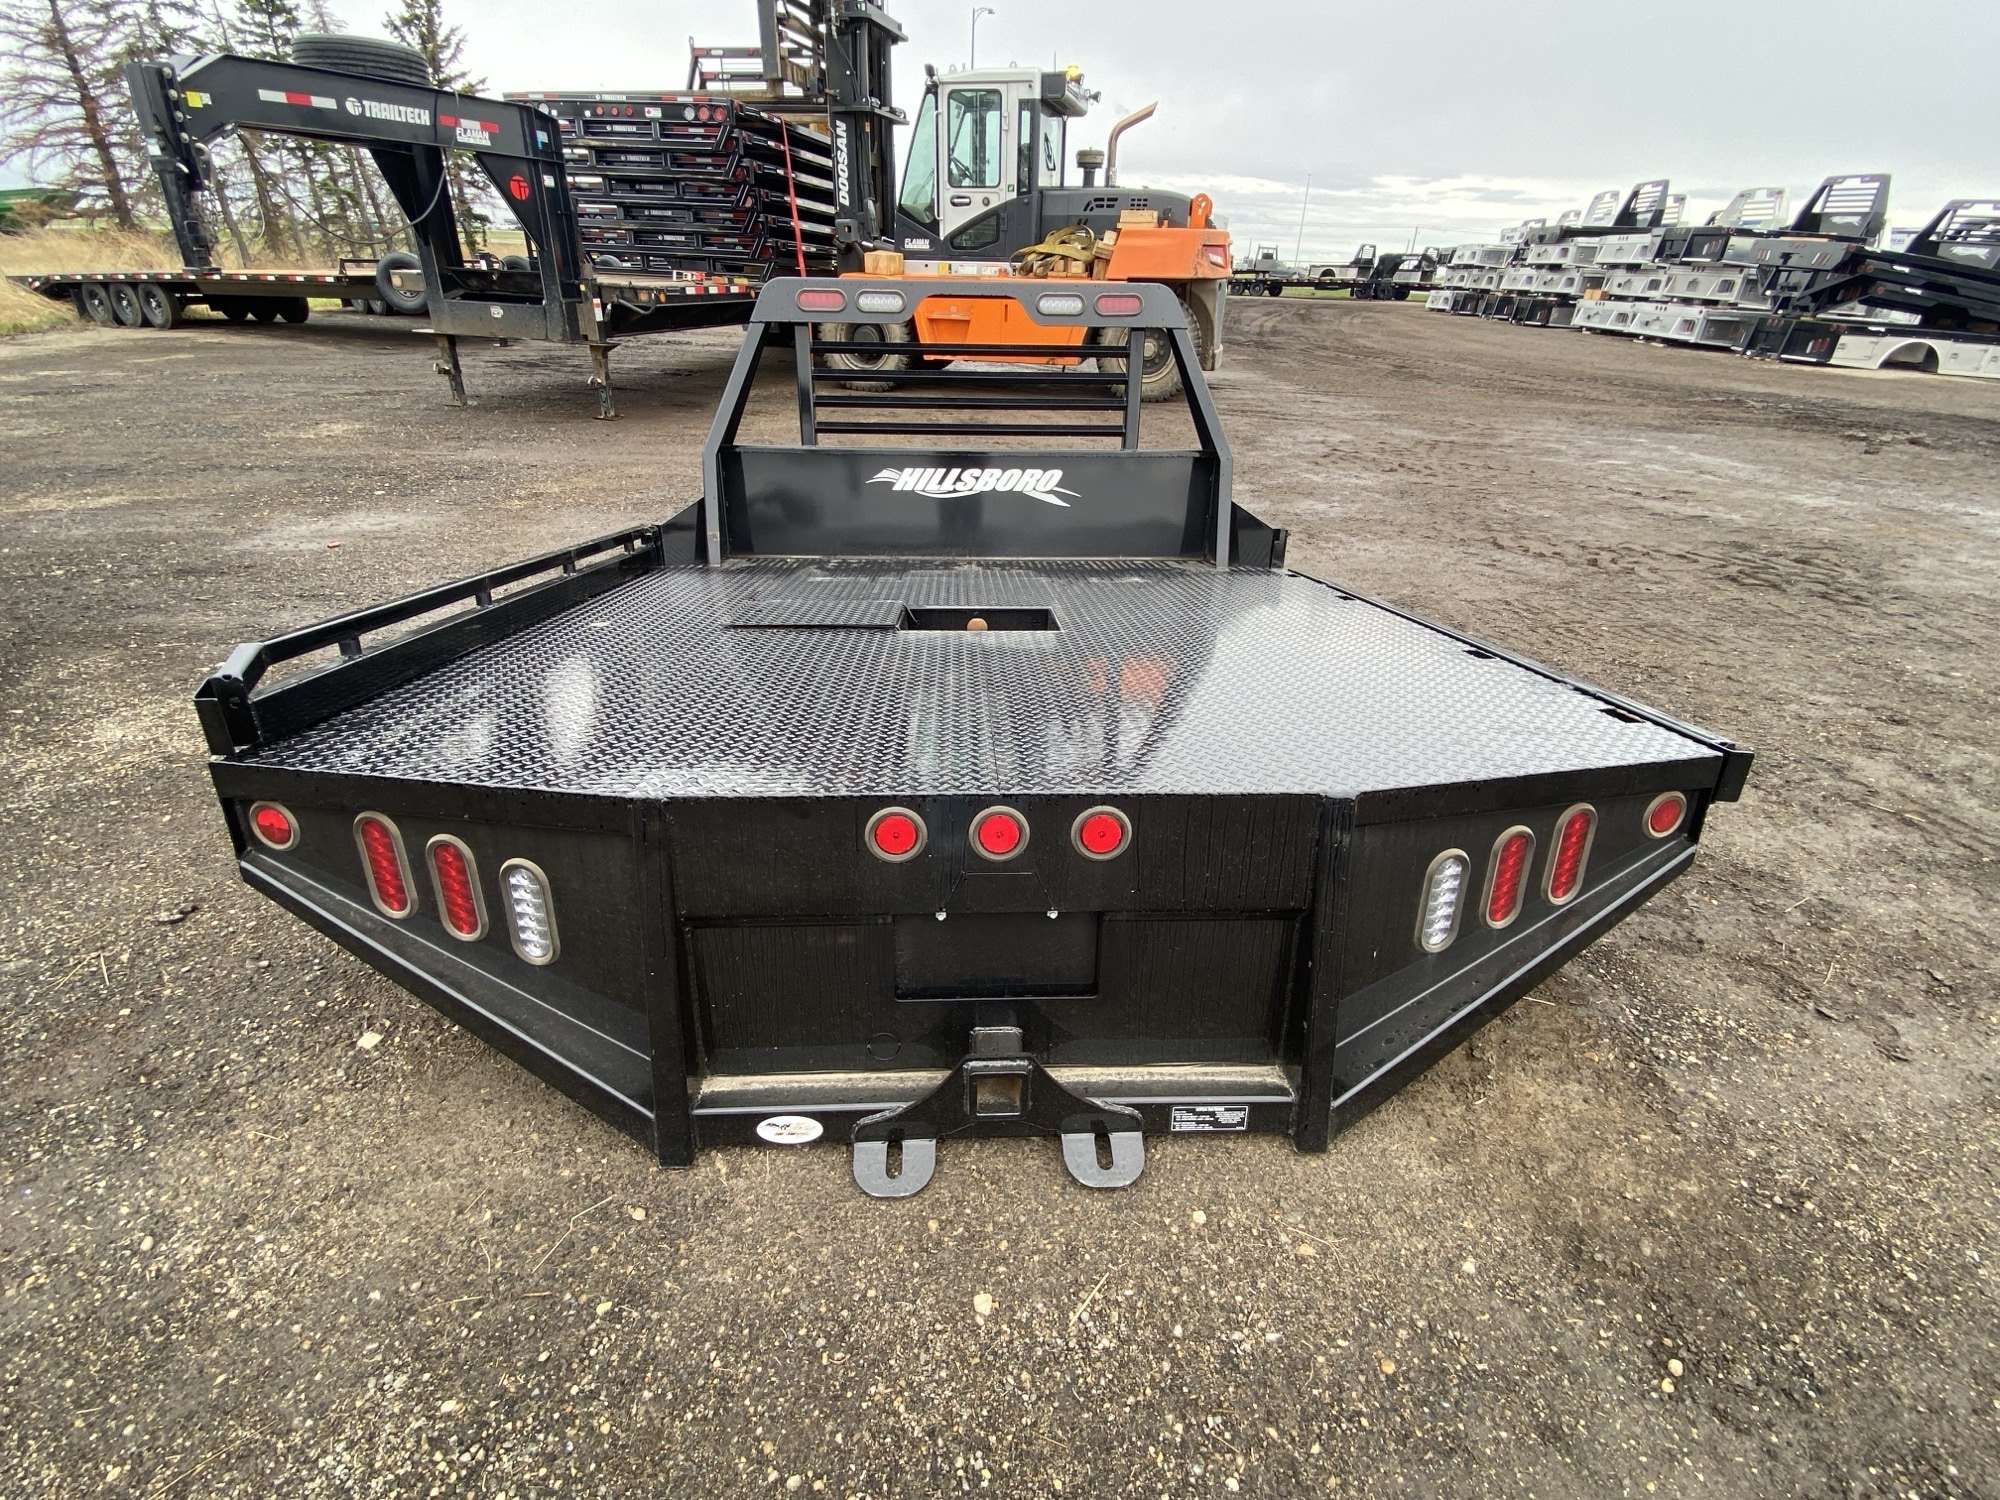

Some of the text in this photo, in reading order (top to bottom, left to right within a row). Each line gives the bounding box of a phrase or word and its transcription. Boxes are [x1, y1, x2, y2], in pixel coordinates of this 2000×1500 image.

[363, 101, 430, 125] TRAILTECH
[456, 128, 489, 140] FLAMAN
[836, 120, 849, 206] DOOSAN
[892, 468, 1063, 492] HILLSBORO
